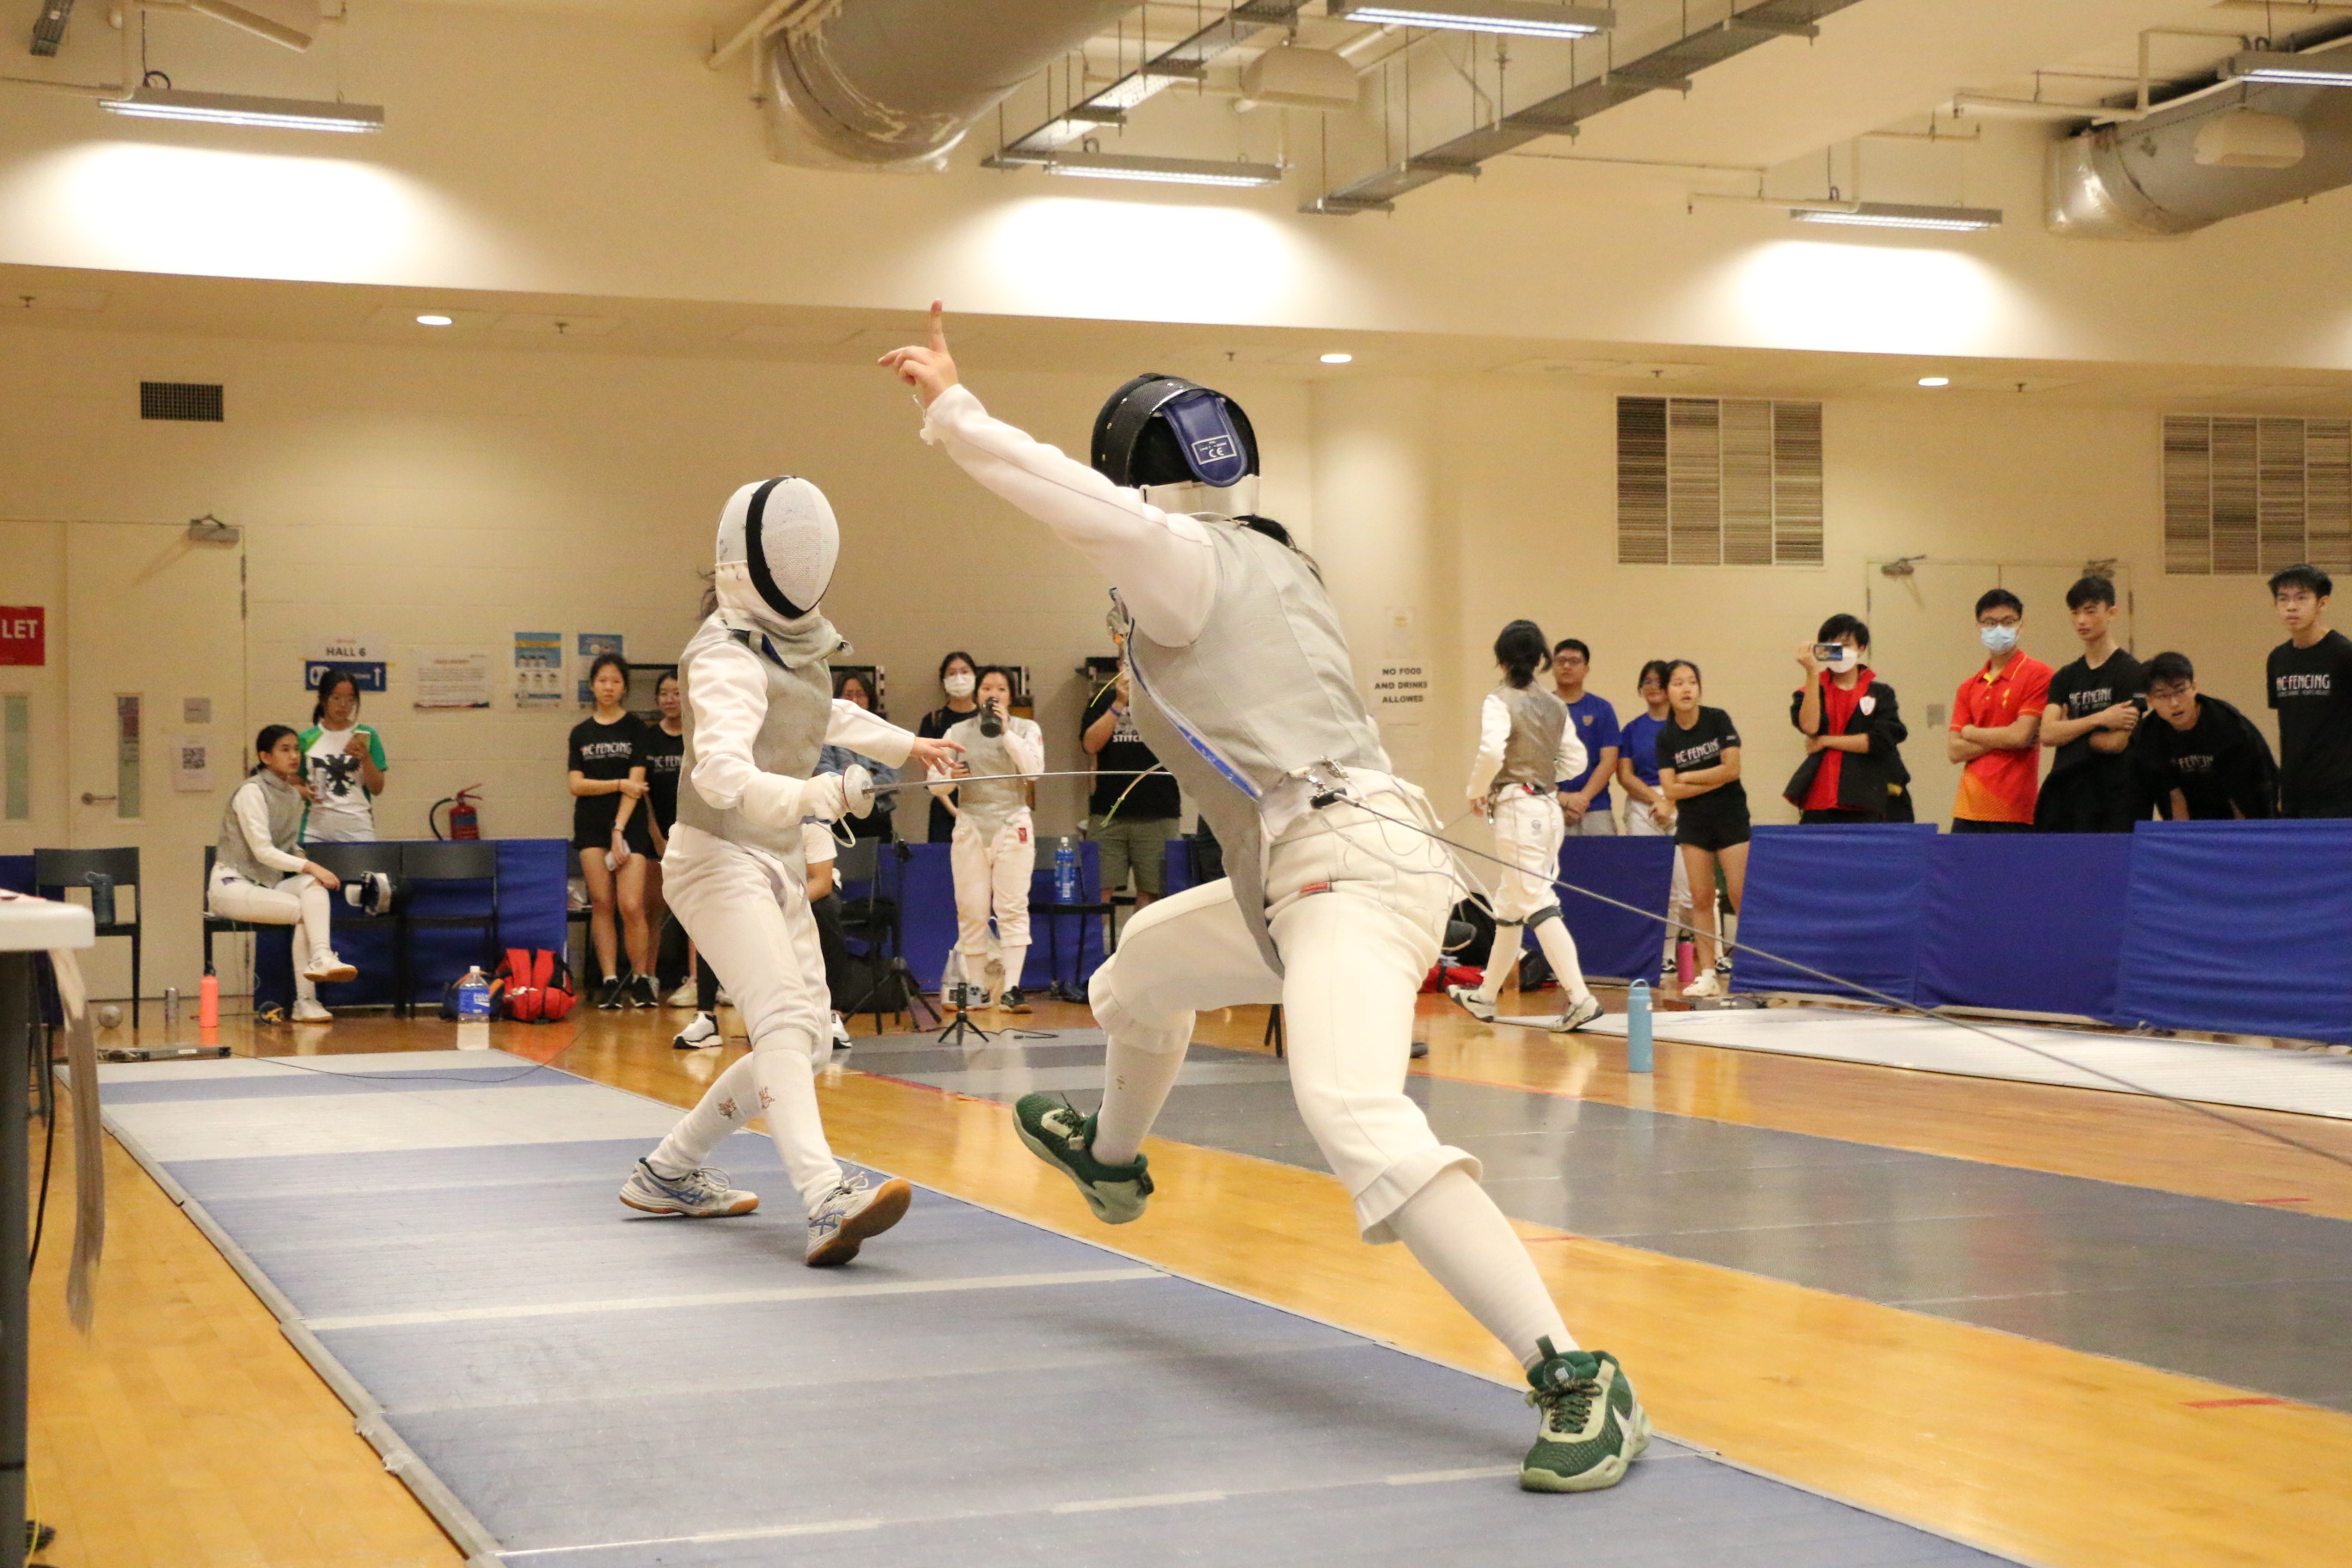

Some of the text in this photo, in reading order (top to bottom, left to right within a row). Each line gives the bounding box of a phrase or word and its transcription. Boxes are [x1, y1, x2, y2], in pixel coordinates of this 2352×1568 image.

[2, 619, 39, 639] LET
[326, 646, 366, 657] HALL 6
[1398, 681, 1428, 689] DRINKS
[2288, 673, 2331, 690] FENCING
[1382, 695, 1424, 703] ALLOWED
[1112, 734, 1141, 743] STITC
